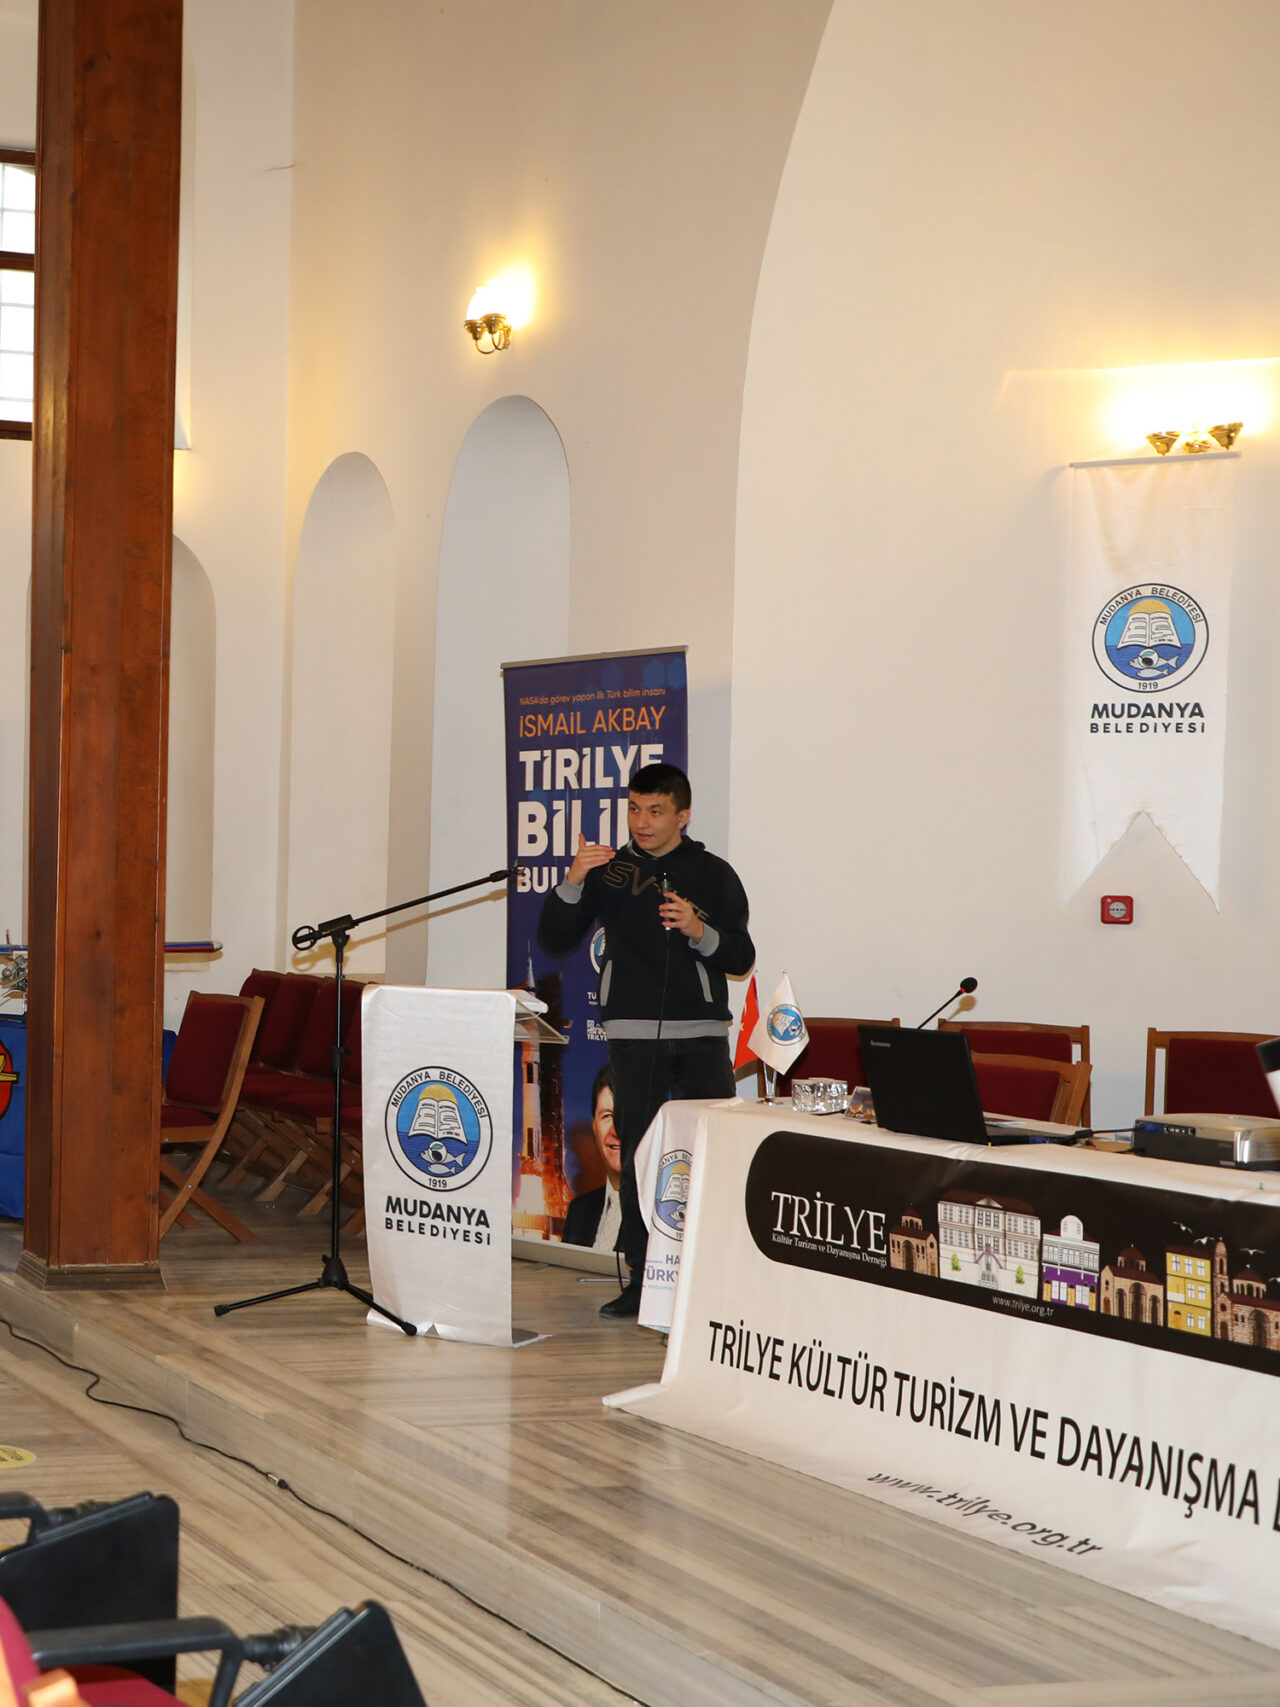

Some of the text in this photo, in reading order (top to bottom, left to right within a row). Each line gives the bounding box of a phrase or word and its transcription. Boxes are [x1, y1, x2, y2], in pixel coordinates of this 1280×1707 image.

[1100, 587, 1204, 626] MUDANYA BELEDİYESİ
[1137, 681, 1159, 690] 1919
[519, 705, 666, 738] İSMAİL AKBAY
[1090, 702, 1205, 719] MUDANYA
[1089, 722, 1206, 734] BELEDİYESİ
[391, 1071, 488, 1119] MUDANYA BELEDİYESİ
[428, 1177, 448, 1188] 1919
[385, 1195, 491, 1229] MUDANYA
[771, 1191, 887, 1255] TRİLYE
[384, 1217, 491, 1246] BELEDİYESİ
[771, 1233, 887, 1268] Kültür Turizm ve Dayanışma Derneği
[991, 1295, 1054, 1317] www.trilye.org.tr
[708, 1319, 785, 1381] TRİLYE
[787, 1338, 888, 1412] KÜLTÜR
[893, 1375, 1002, 1446] TURİZM
[1009, 1402, 1049, 1460] VE
[1056, 1415, 1260, 1526] DAYANIŞMA
[866, 1472, 1103, 1556] www.trilye.org.tr
